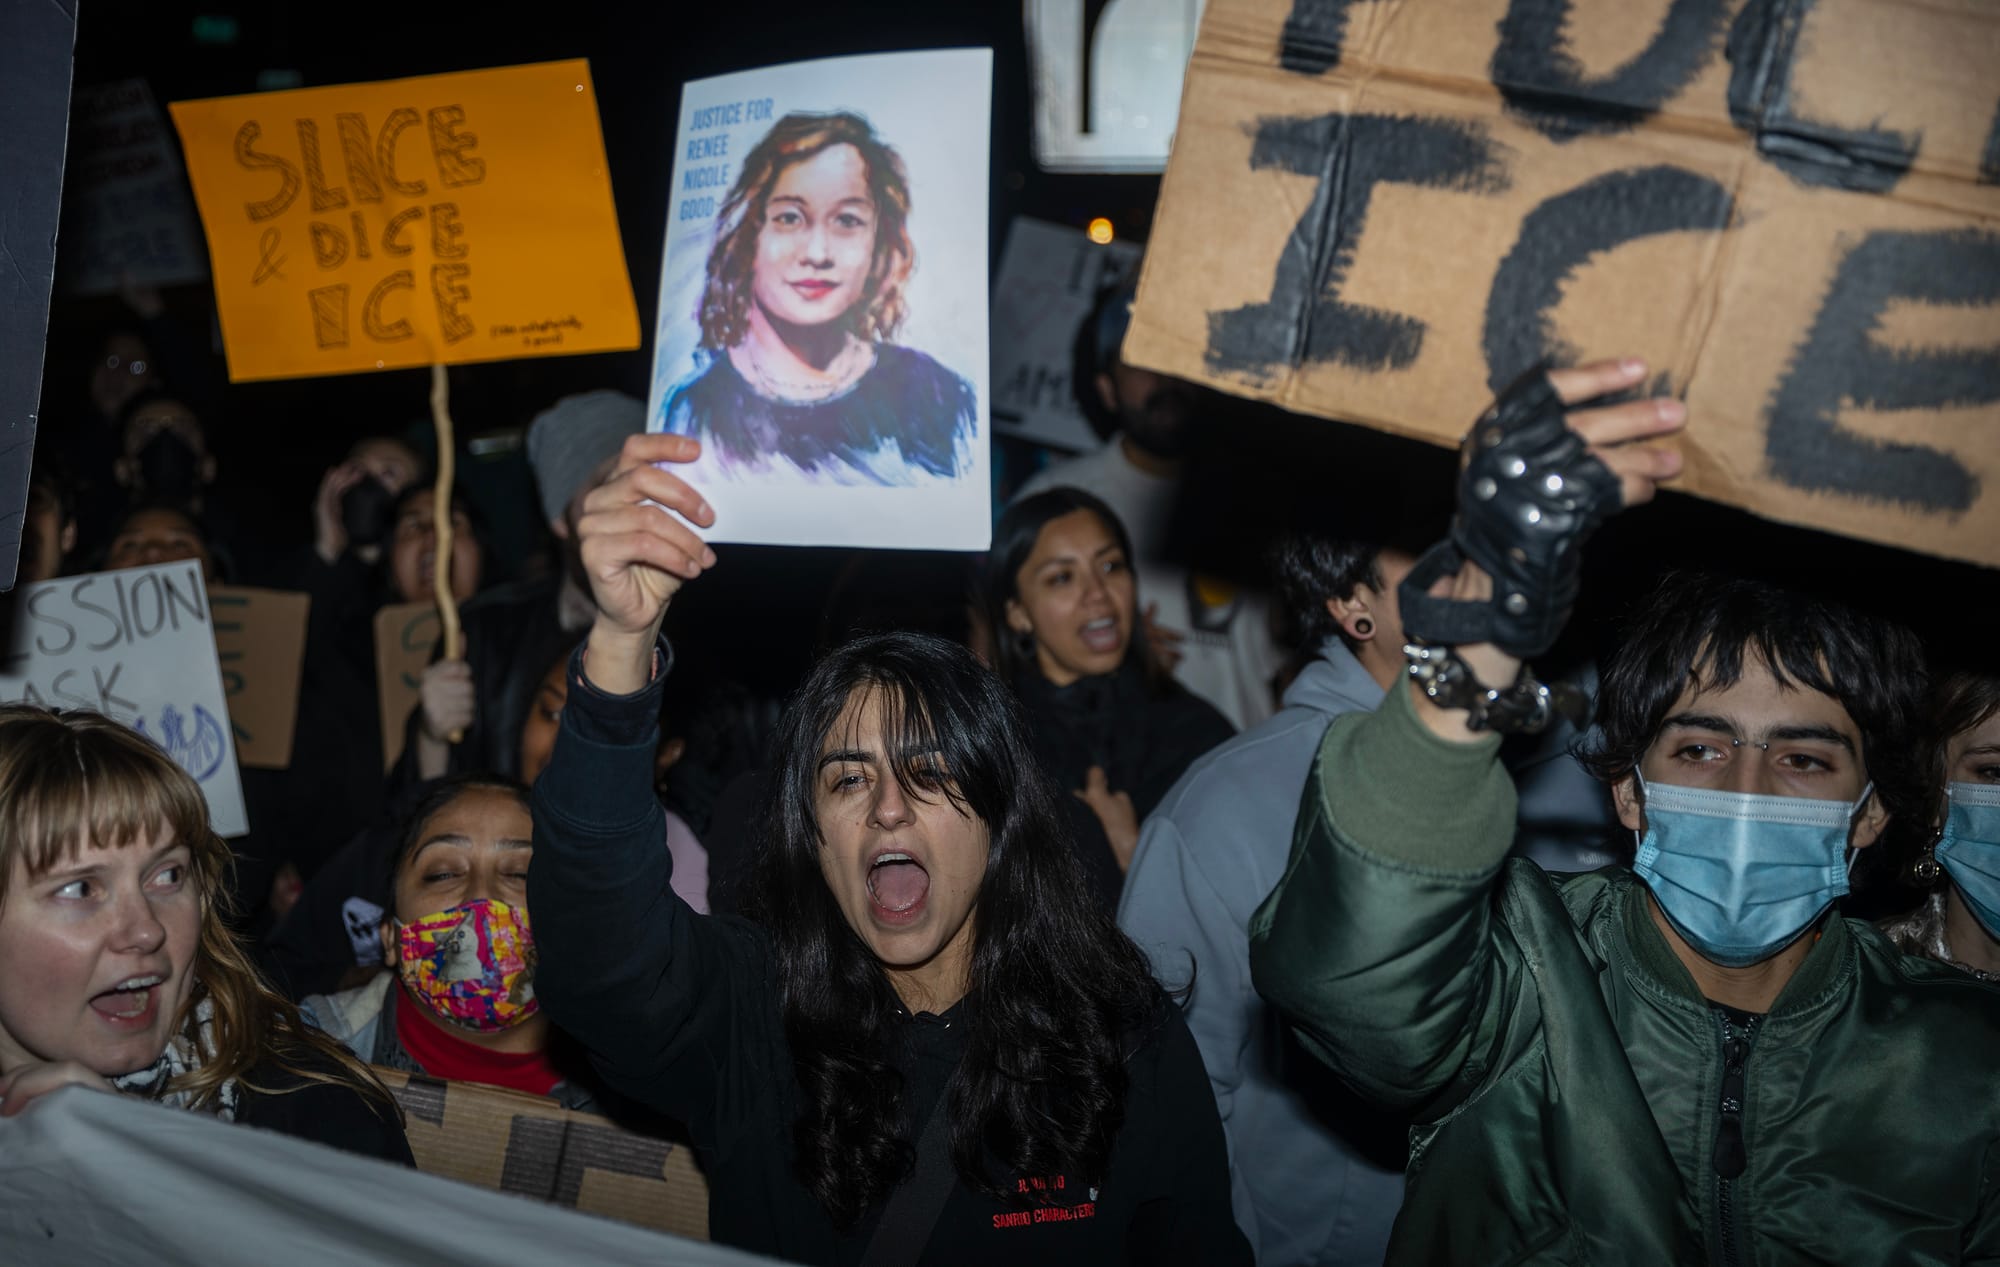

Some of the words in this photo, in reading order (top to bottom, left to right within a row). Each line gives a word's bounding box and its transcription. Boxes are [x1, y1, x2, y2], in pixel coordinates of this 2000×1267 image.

[690, 102, 743, 131] JUSTICE
[745, 97, 774, 121] FOR
[233, 104, 487, 224] SLICE
[686, 134, 729, 160] RENEE
[682, 163, 731, 191] NICOLE
[679, 196, 715, 221] GOOD
[252, 226, 288, 286] &
[308, 202, 470, 271] DICE
[308, 262, 476, 350] ICE
[1205, 111, 2000, 522] ICE
[26, 567, 207, 657] SSION
[992, 1211, 1031, 1229] SANRIO
